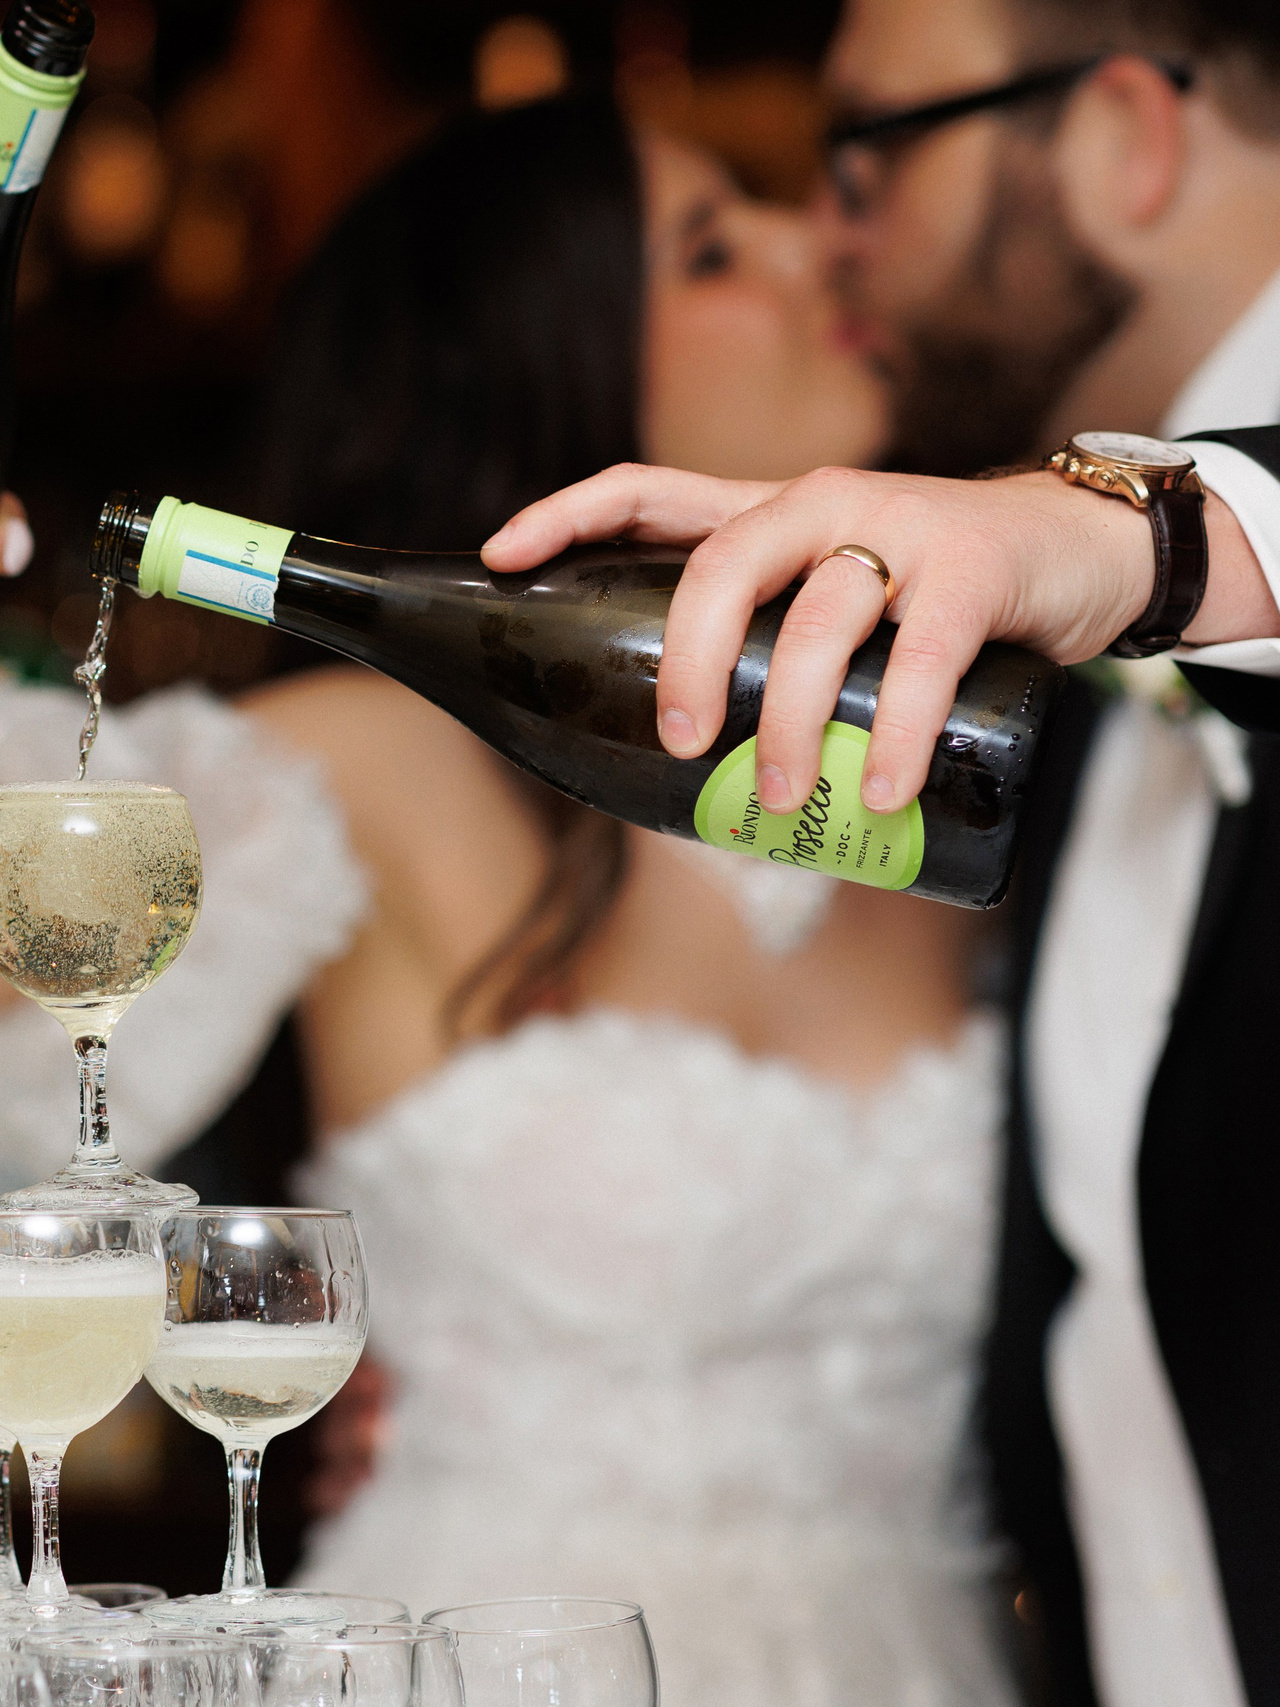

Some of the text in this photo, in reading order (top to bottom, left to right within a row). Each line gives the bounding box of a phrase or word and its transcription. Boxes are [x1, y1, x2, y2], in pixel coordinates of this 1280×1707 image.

[835, 833, 851, 857] DOC
[855, 828, 872, 869] FRIZZANTE
[878, 844, 891, 867] ITALY
